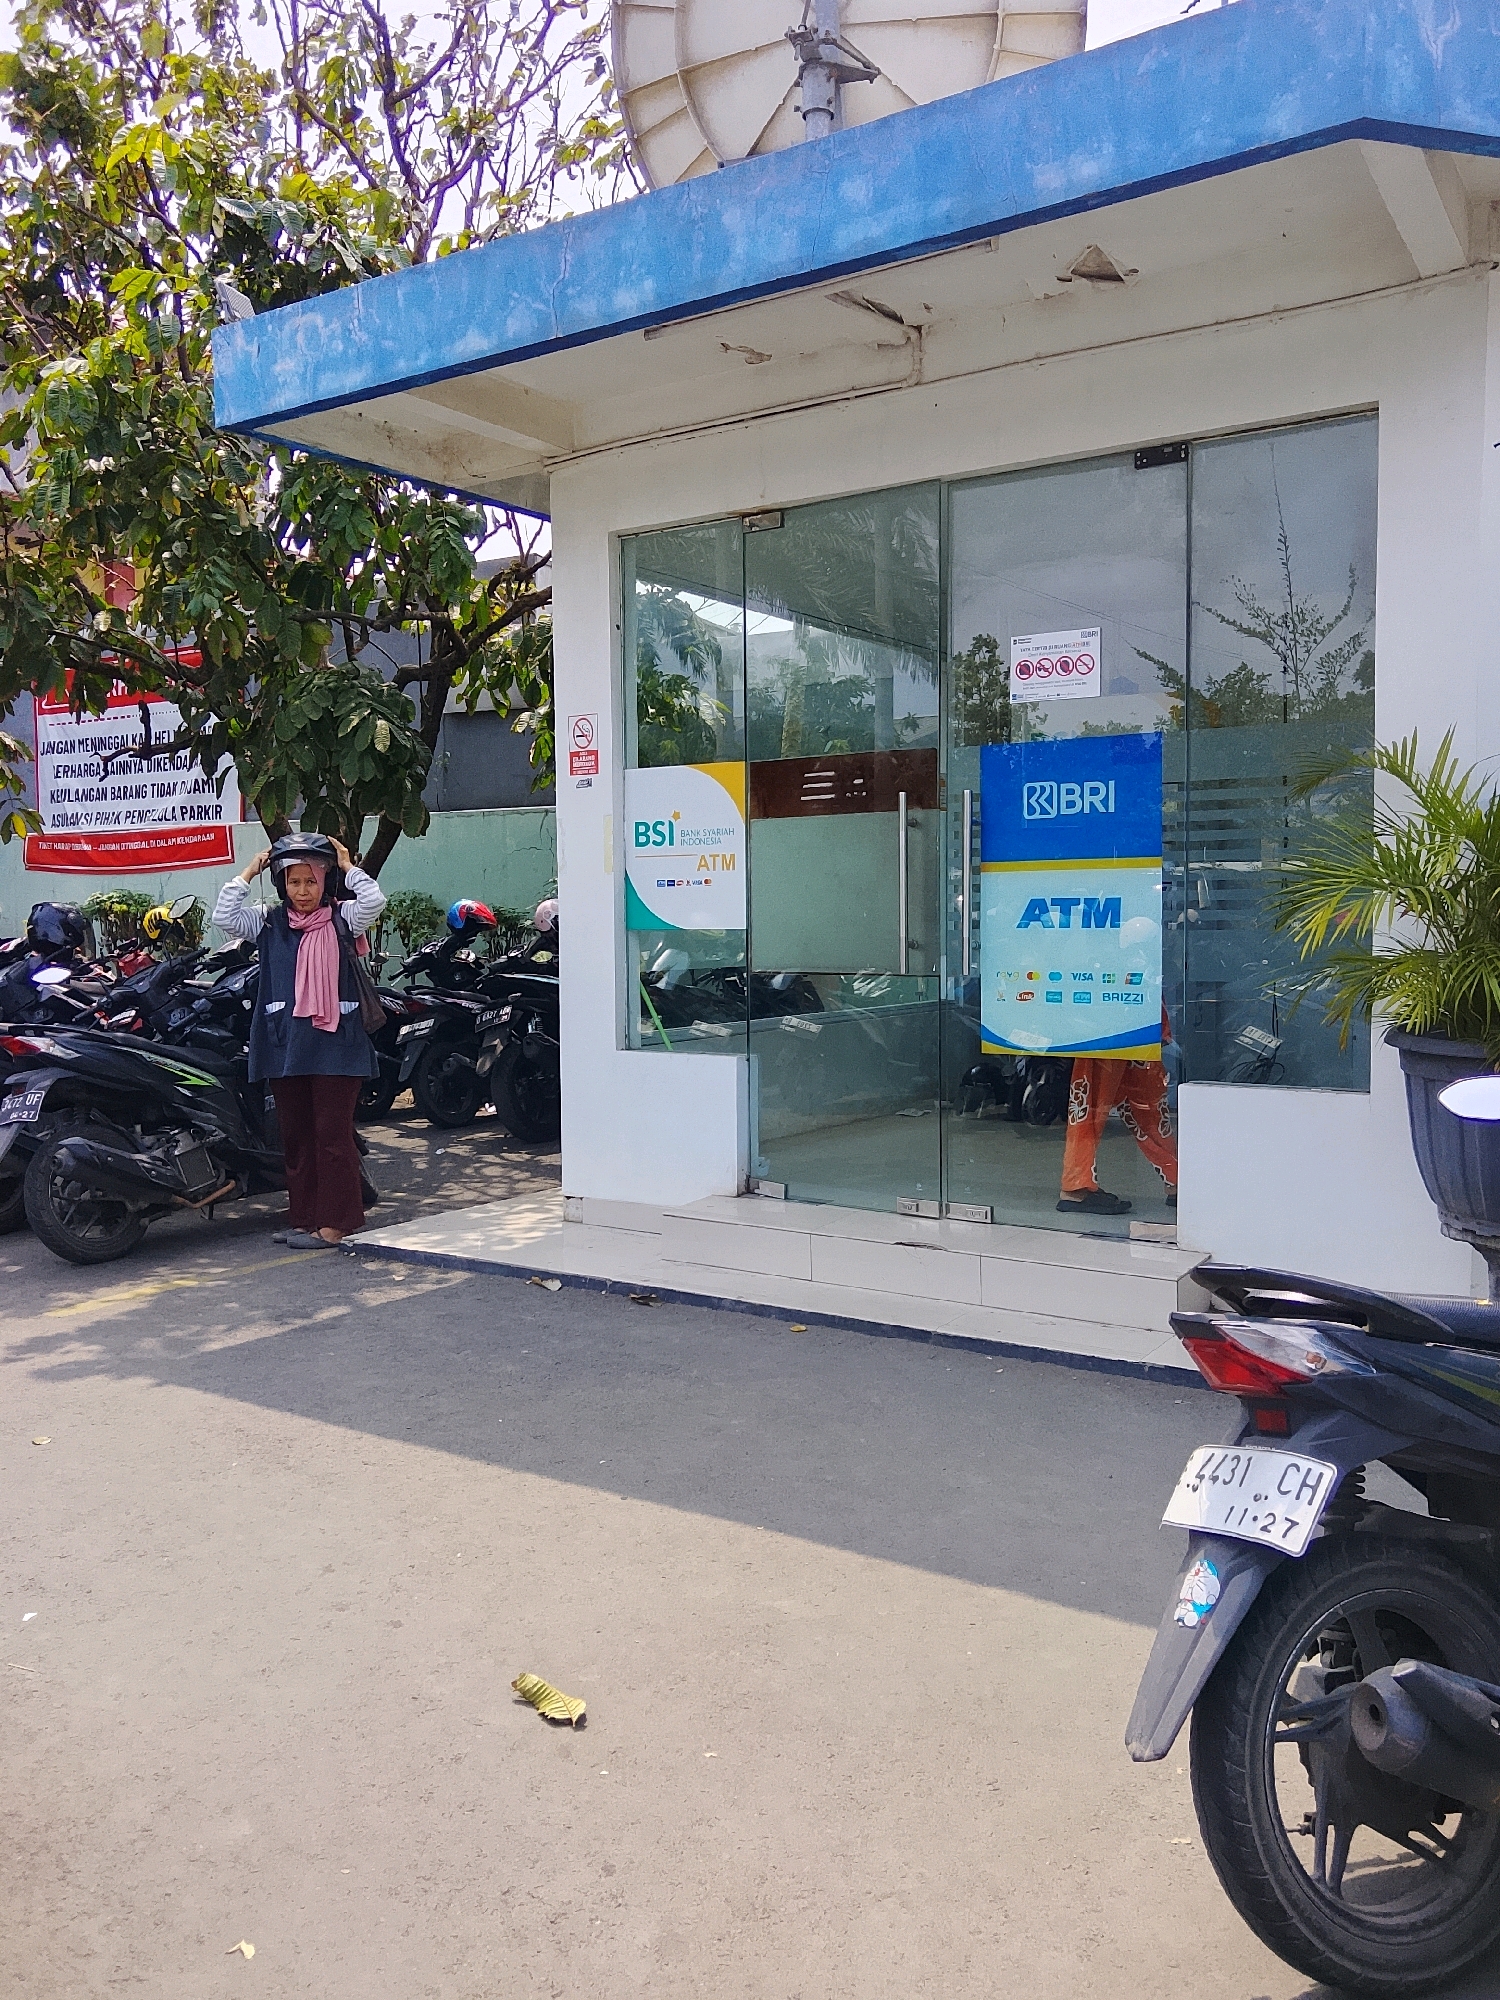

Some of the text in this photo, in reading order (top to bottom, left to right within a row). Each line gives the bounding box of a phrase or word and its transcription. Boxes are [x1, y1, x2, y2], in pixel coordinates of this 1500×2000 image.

[78, 732, 147, 754] MENINGGALKA
[154, 729, 177, 746] HEL
[53, 762, 100, 779] ERHARGA
[106, 758, 144, 775] AINNYA
[110, 784, 148, 801] BARANG
[151, 781, 178, 799] TIDAK
[1060, 779, 1116, 815] BRI
[180, 804, 223, 821] PARKIR
[156, 837, 177, 847] DALAM
[635, 819, 675, 848] BSI
[680, 827, 735, 838] BANK SYARIAH
[680, 837, 722, 846] INDONESIA
[697, 853, 736, 872] ATM
[1016, 896, 1122, 929] ATM
[1071, 972, 1094, 981] VISA
[1102, 992, 1143, 1003] BRIZZI
[26, 1094, 42, 1105] UF
[1195, 1452, 1325, 1506] 4431 CH
